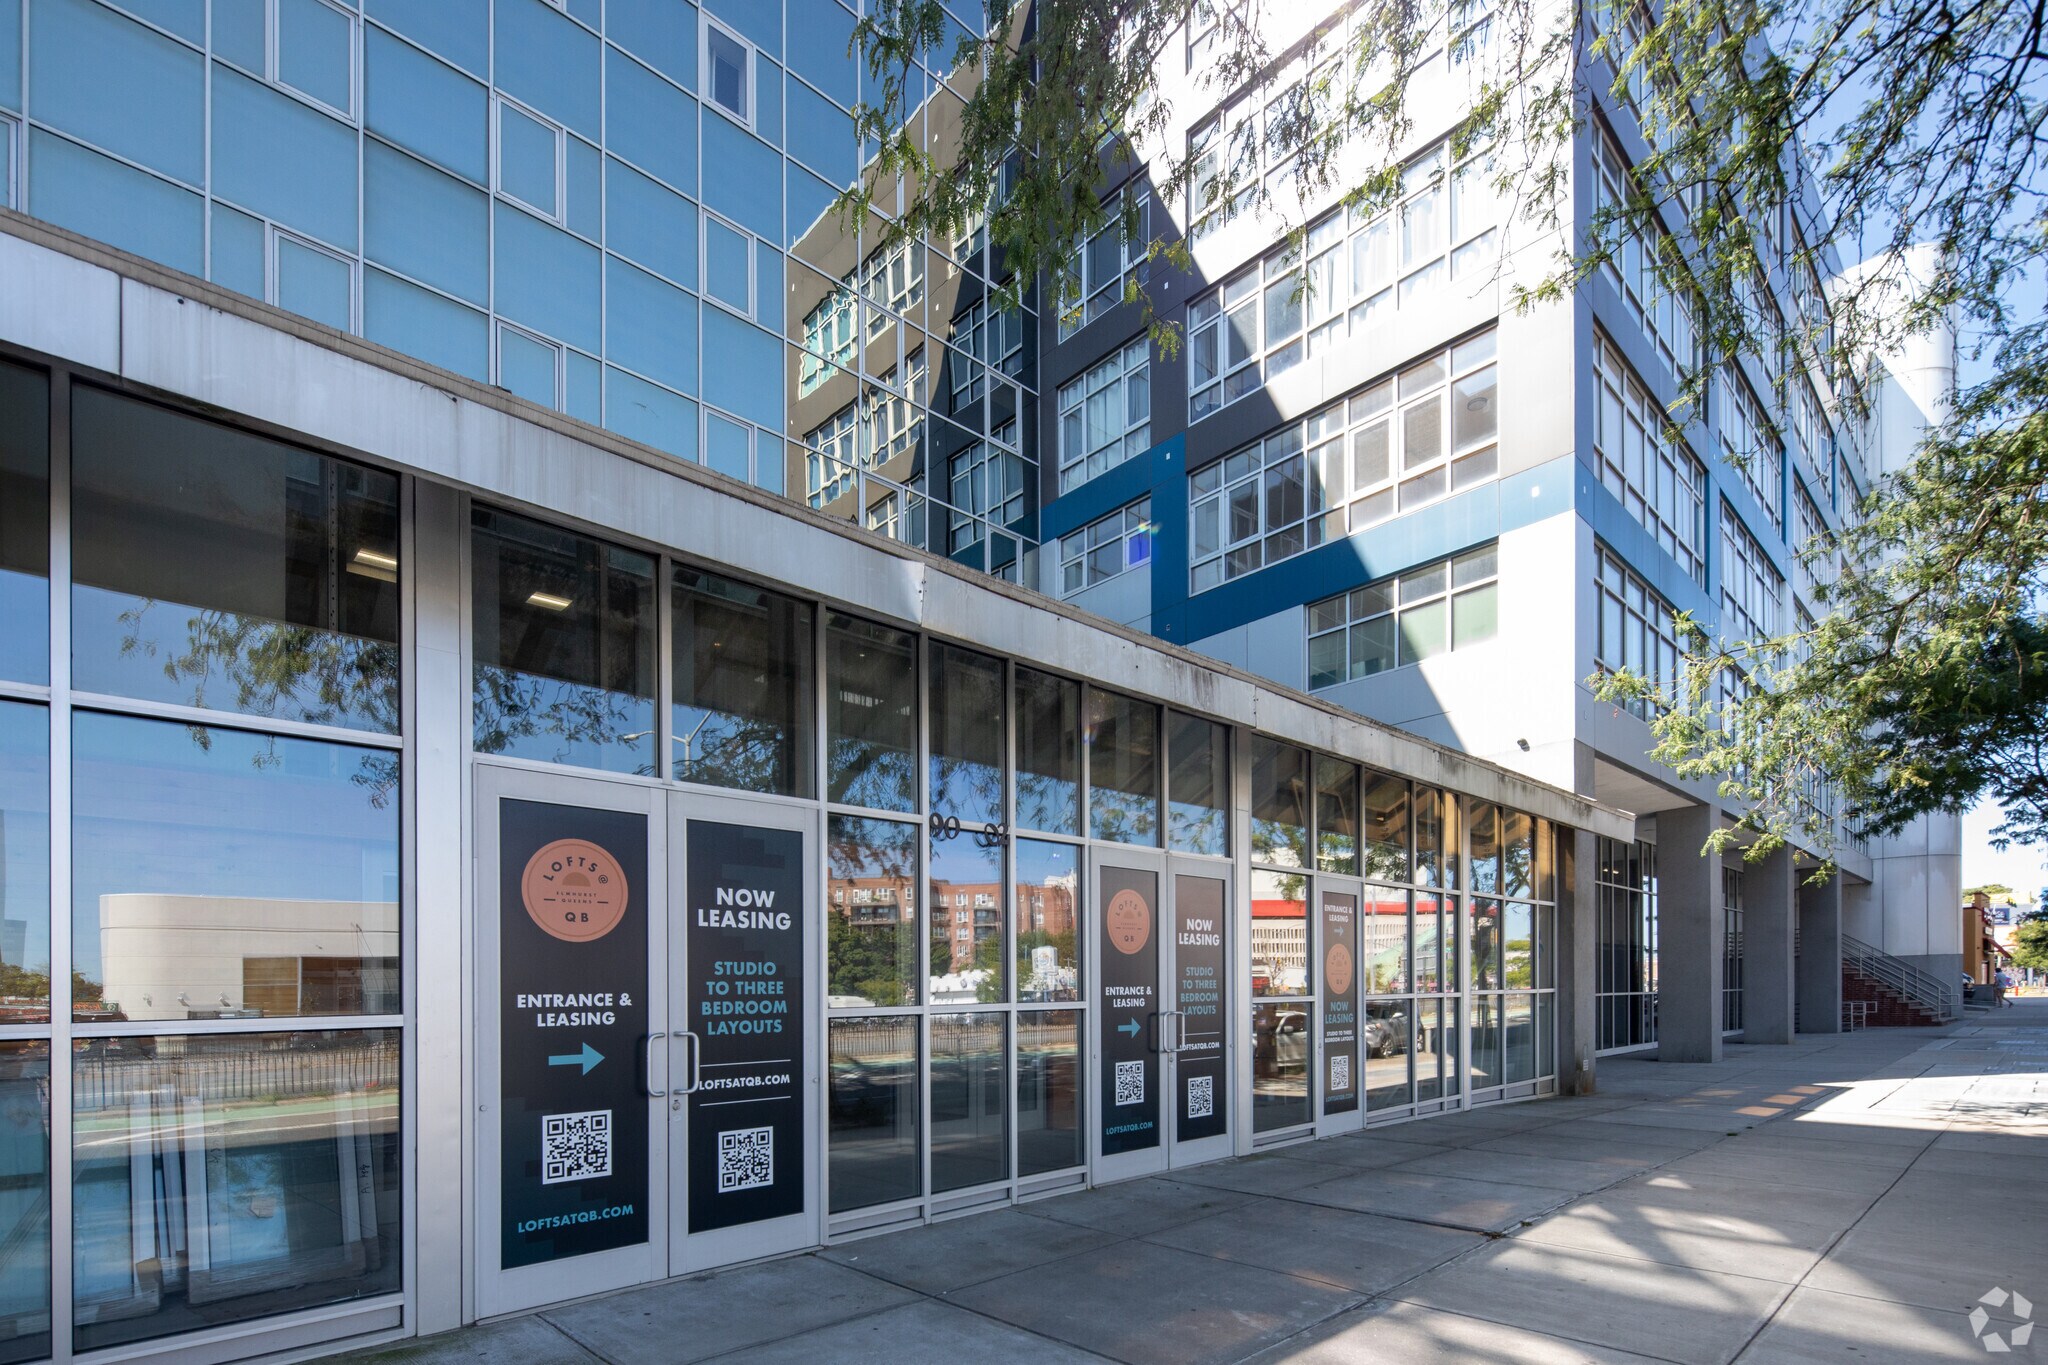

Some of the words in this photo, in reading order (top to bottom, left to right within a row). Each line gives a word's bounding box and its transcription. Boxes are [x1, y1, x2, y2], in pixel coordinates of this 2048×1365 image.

[716, 888, 775, 908] NOW
[1324, 904, 1348, 913] ENTRANCE
[565, 912, 589, 922] QB
[698, 909, 791, 930] LEASING
[1329, 915, 1349, 923] LEASING
[1187, 918, 1212, 931] NOW
[1179, 933, 1220, 946] LEASING
[714, 961, 777, 976] STUDIO
[1186, 967, 1213, 976] STUDIO
[706, 981, 729, 996] TO
[735, 981, 784, 995] THREE
[1105, 986, 1144, 996] ENTRANCE
[1146, 986, 1152, 995] &
[1183, 980, 1193, 989] TO
[1195, 980, 1217, 989] THREE
[517, 993, 613, 1008] ENTRANCE
[619, 993, 632, 1006] &
[1113, 998, 1145, 1007] LEASING
[1180, 993, 1218, 1002] BEDROOM
[702, 1000, 788, 1016] BEDROOM
[1183, 1006, 1216, 1015] LAYOUTS
[1331, 1002, 1349, 1011] NOW
[537, 1011, 616, 1027] LEASING
[1325, 1013, 1354, 1024] LEASING
[708, 1019, 782, 1035] LAYOUTS
[699, 1074, 790, 1090] LOFTSATQB.COM
[1106, 1121, 1153, 1135] LOFTSATQB.COM
[518, 1204, 634, 1233] LOFTSATQB.COM
